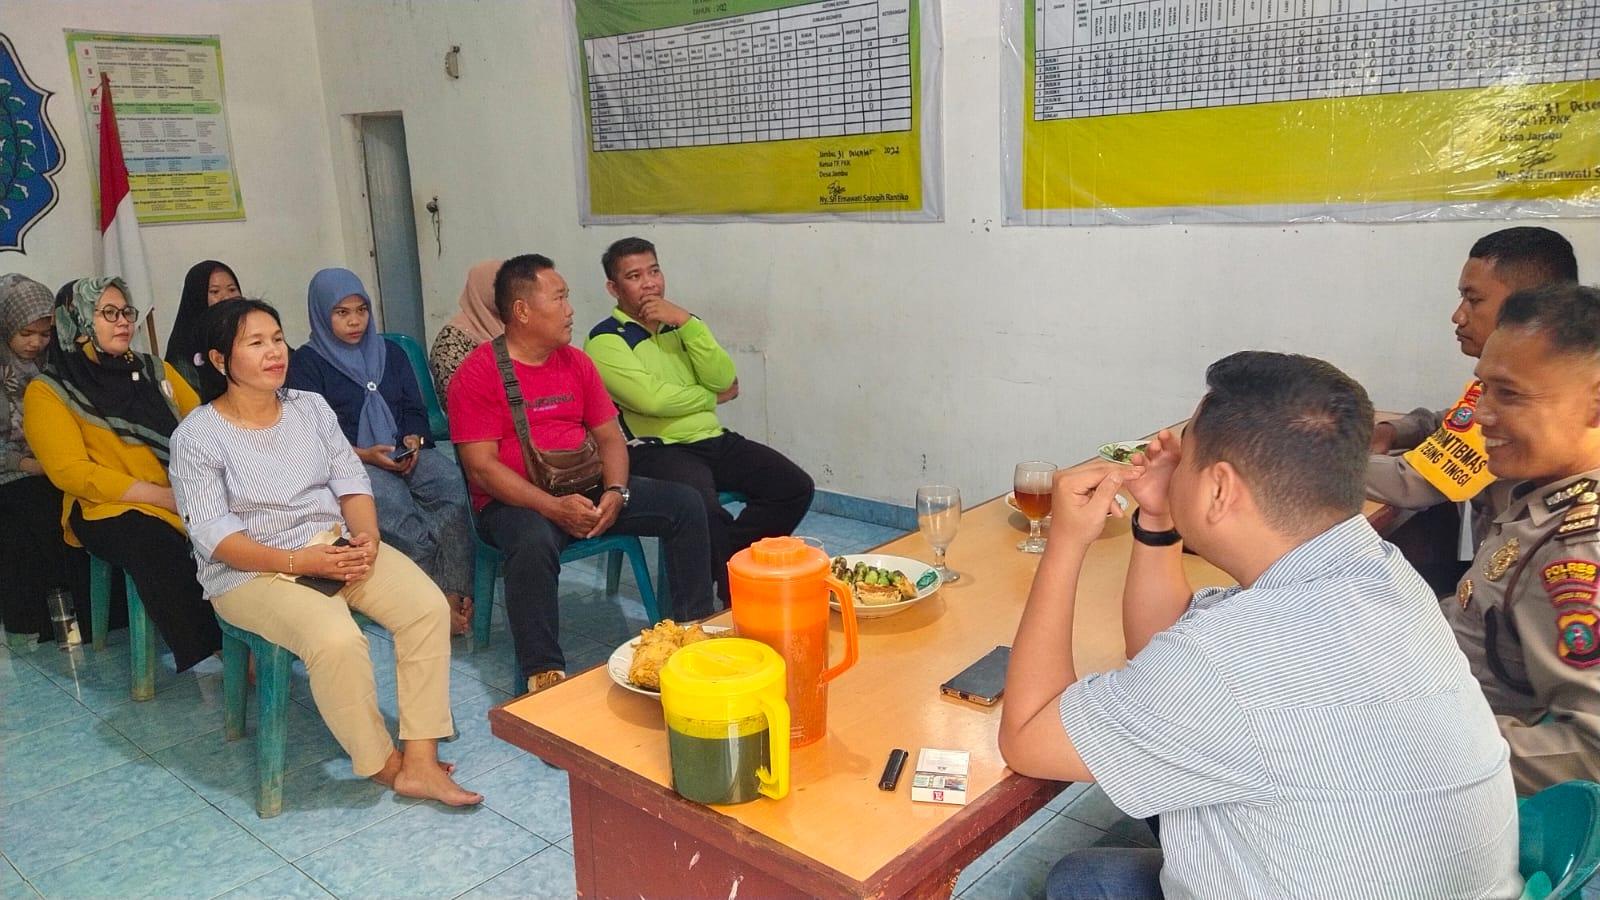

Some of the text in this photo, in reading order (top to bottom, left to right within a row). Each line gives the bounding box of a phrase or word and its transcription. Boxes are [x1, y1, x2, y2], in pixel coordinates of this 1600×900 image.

[1537, 167, 1591, 180] Ernawati
[1441, 458, 1472, 488] TINGGI
[1545, 562, 1597, 580] POLRES
